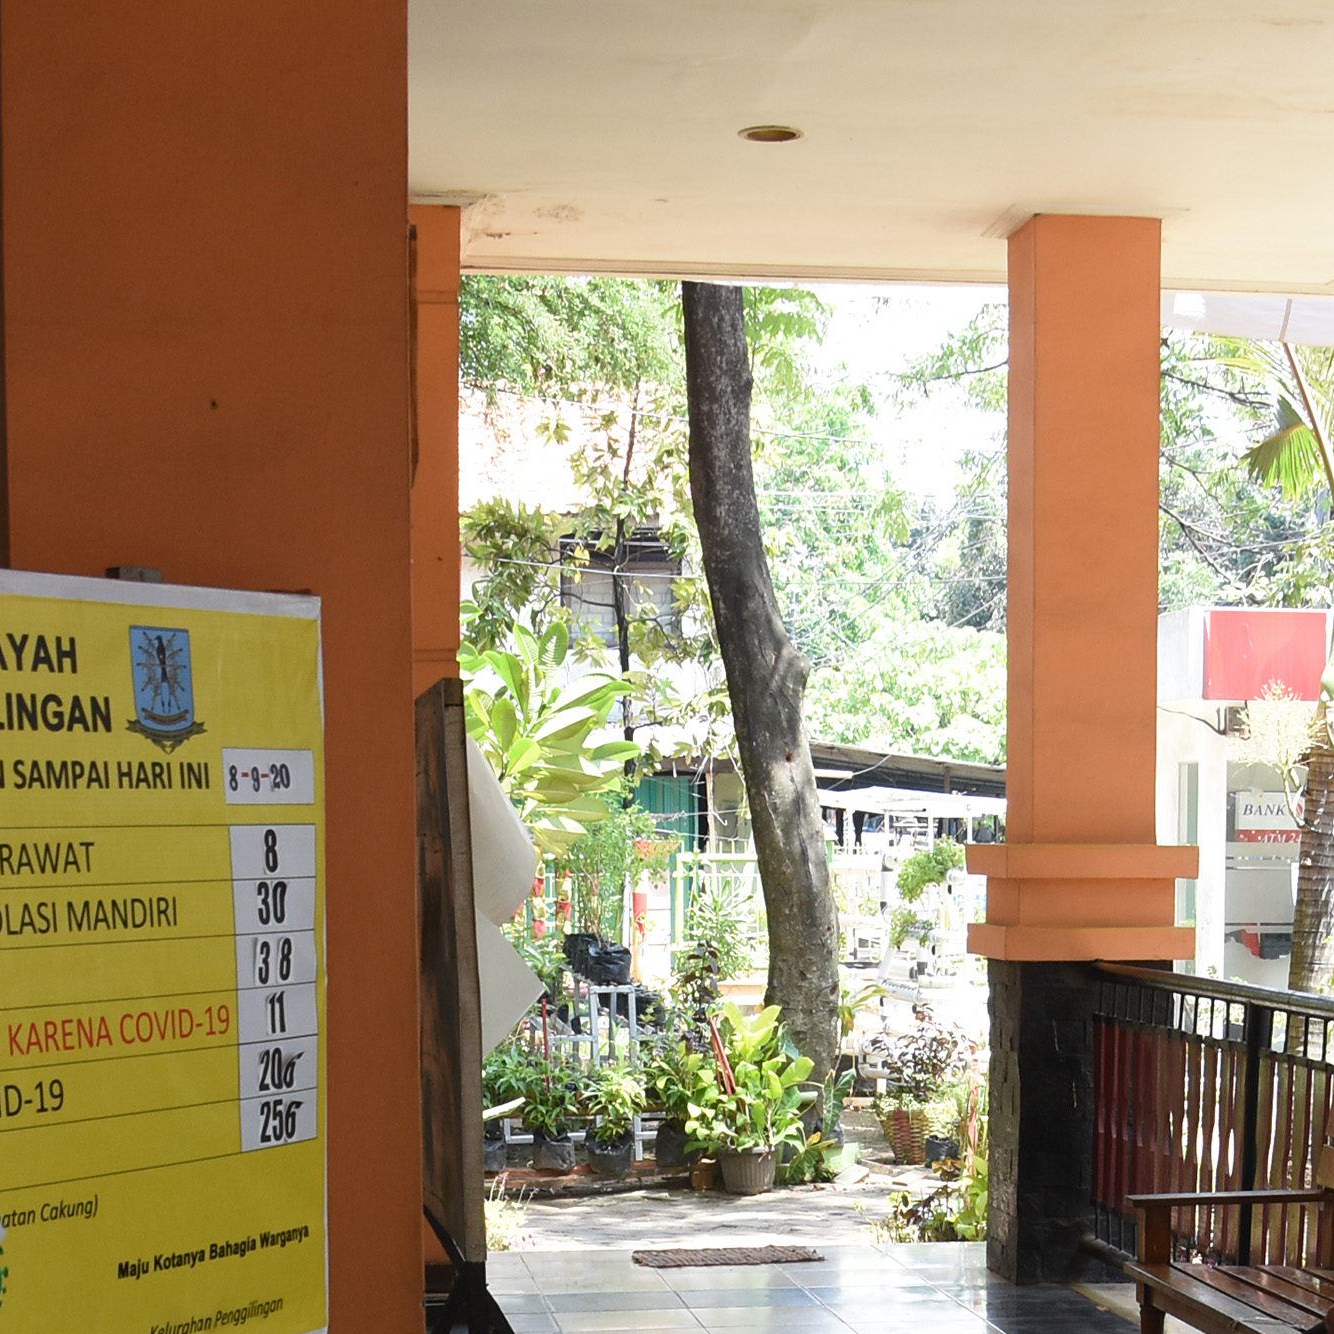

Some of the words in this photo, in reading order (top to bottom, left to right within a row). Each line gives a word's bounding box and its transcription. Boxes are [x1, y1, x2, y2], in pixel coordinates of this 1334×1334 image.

[13, 759, 109, 790] SAMPAI
[117, 761, 172, 790] HARI
[180, 762, 210, 790] INI
[1242, 803, 1287, 816] BANK
[0, 841, 95, 876] RAWAT
[264, 829, 278, 874] 8
[67, 896, 178, 932] MANDIRI
[258, 881, 287, 925] 30
[9, 1016, 113, 1057] KARENA
[120, 1004, 231, 1045] COVID-19
[268, 991, 287, 1034] 11
[259, 1098, 304, 1143] 256
[40, 1193, 98, 1222] Cakung)
[118, 1261, 149, 1279] Maju
[154, 1249, 205, 1272] Kotanya
[209, 1236, 256, 1260] Bahagia
[260, 1225, 309, 1248] Warganya
[215, 1298, 284, 1327] Penggilingan
